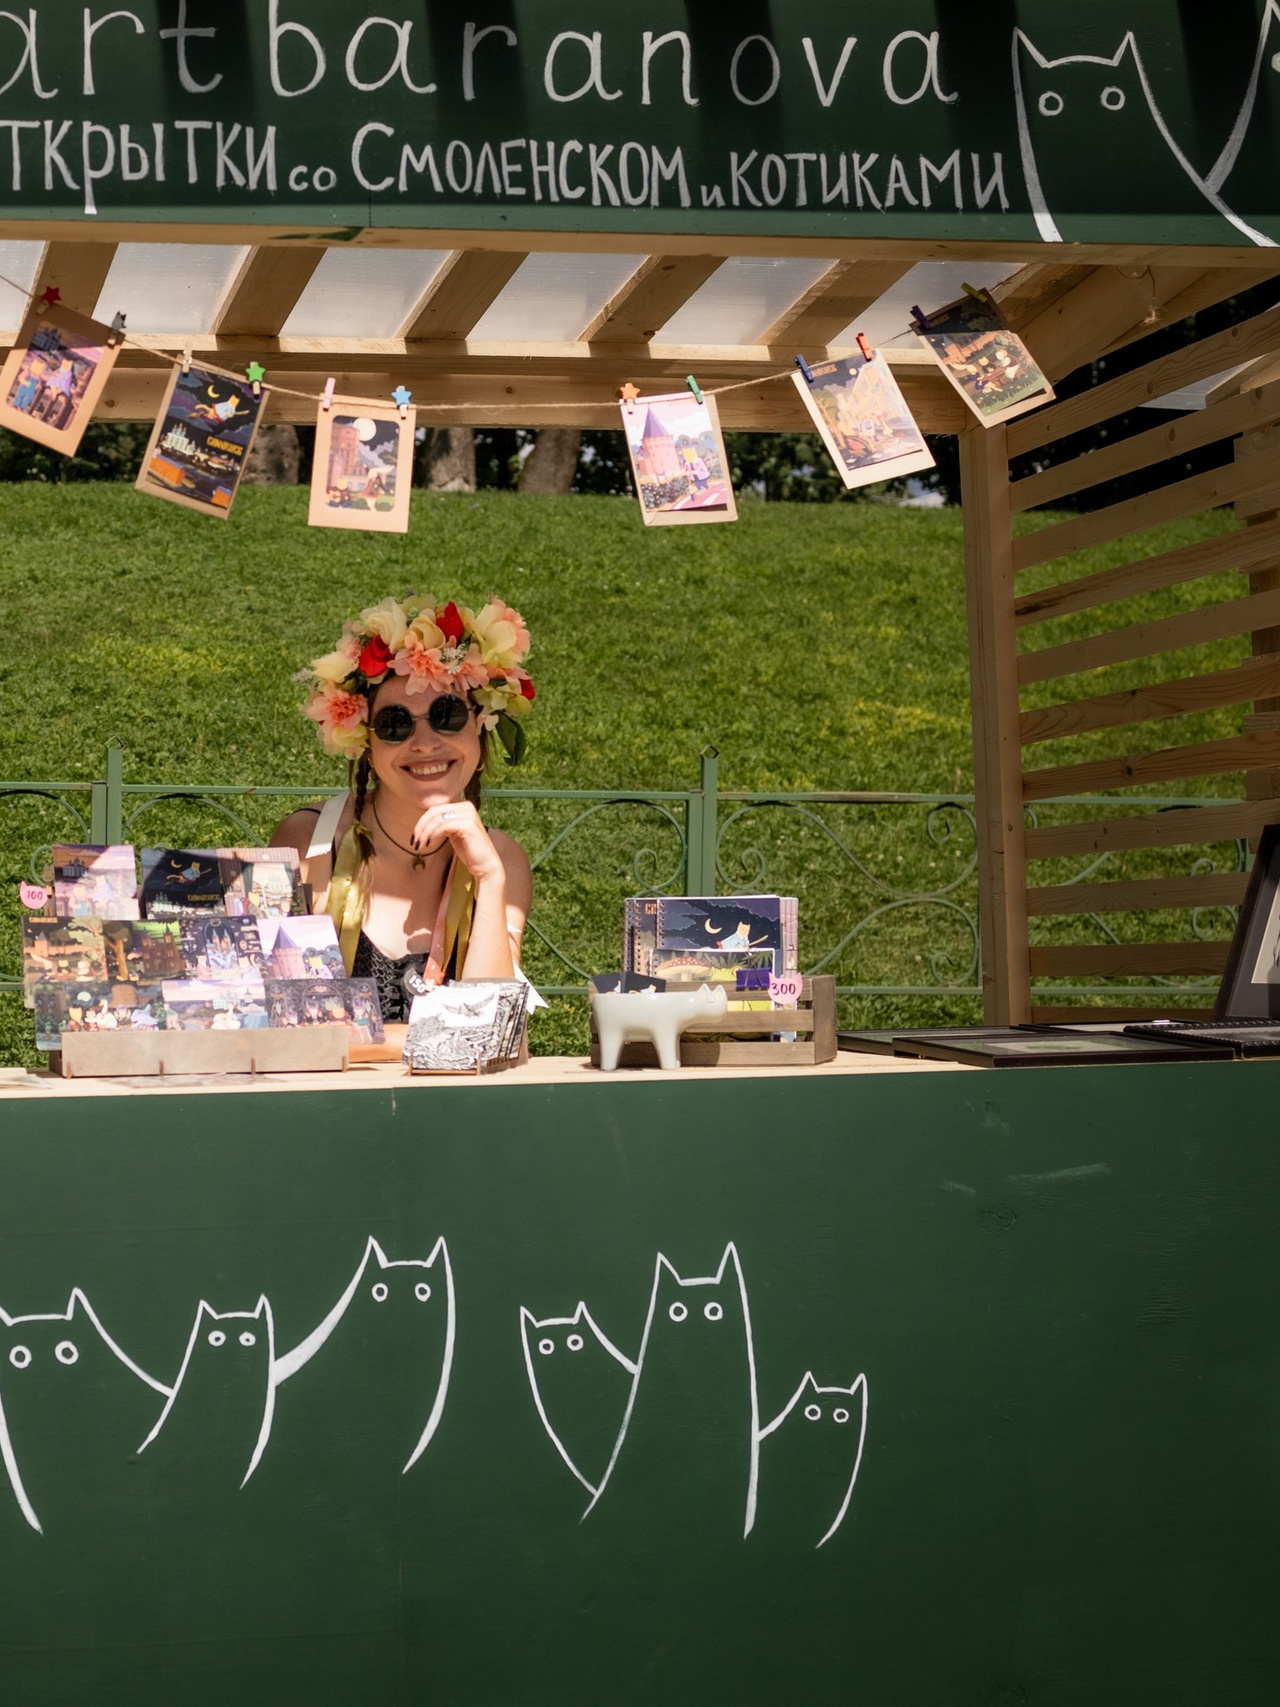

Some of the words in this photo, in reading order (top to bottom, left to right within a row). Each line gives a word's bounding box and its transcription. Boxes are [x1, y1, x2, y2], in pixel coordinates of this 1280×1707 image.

[730, 149, 1009, 212] КОТИКАМИ
[26, 890, 44, 901] 100
[408, 974, 426, 993] 150
[771, 982, 796, 996] 300
